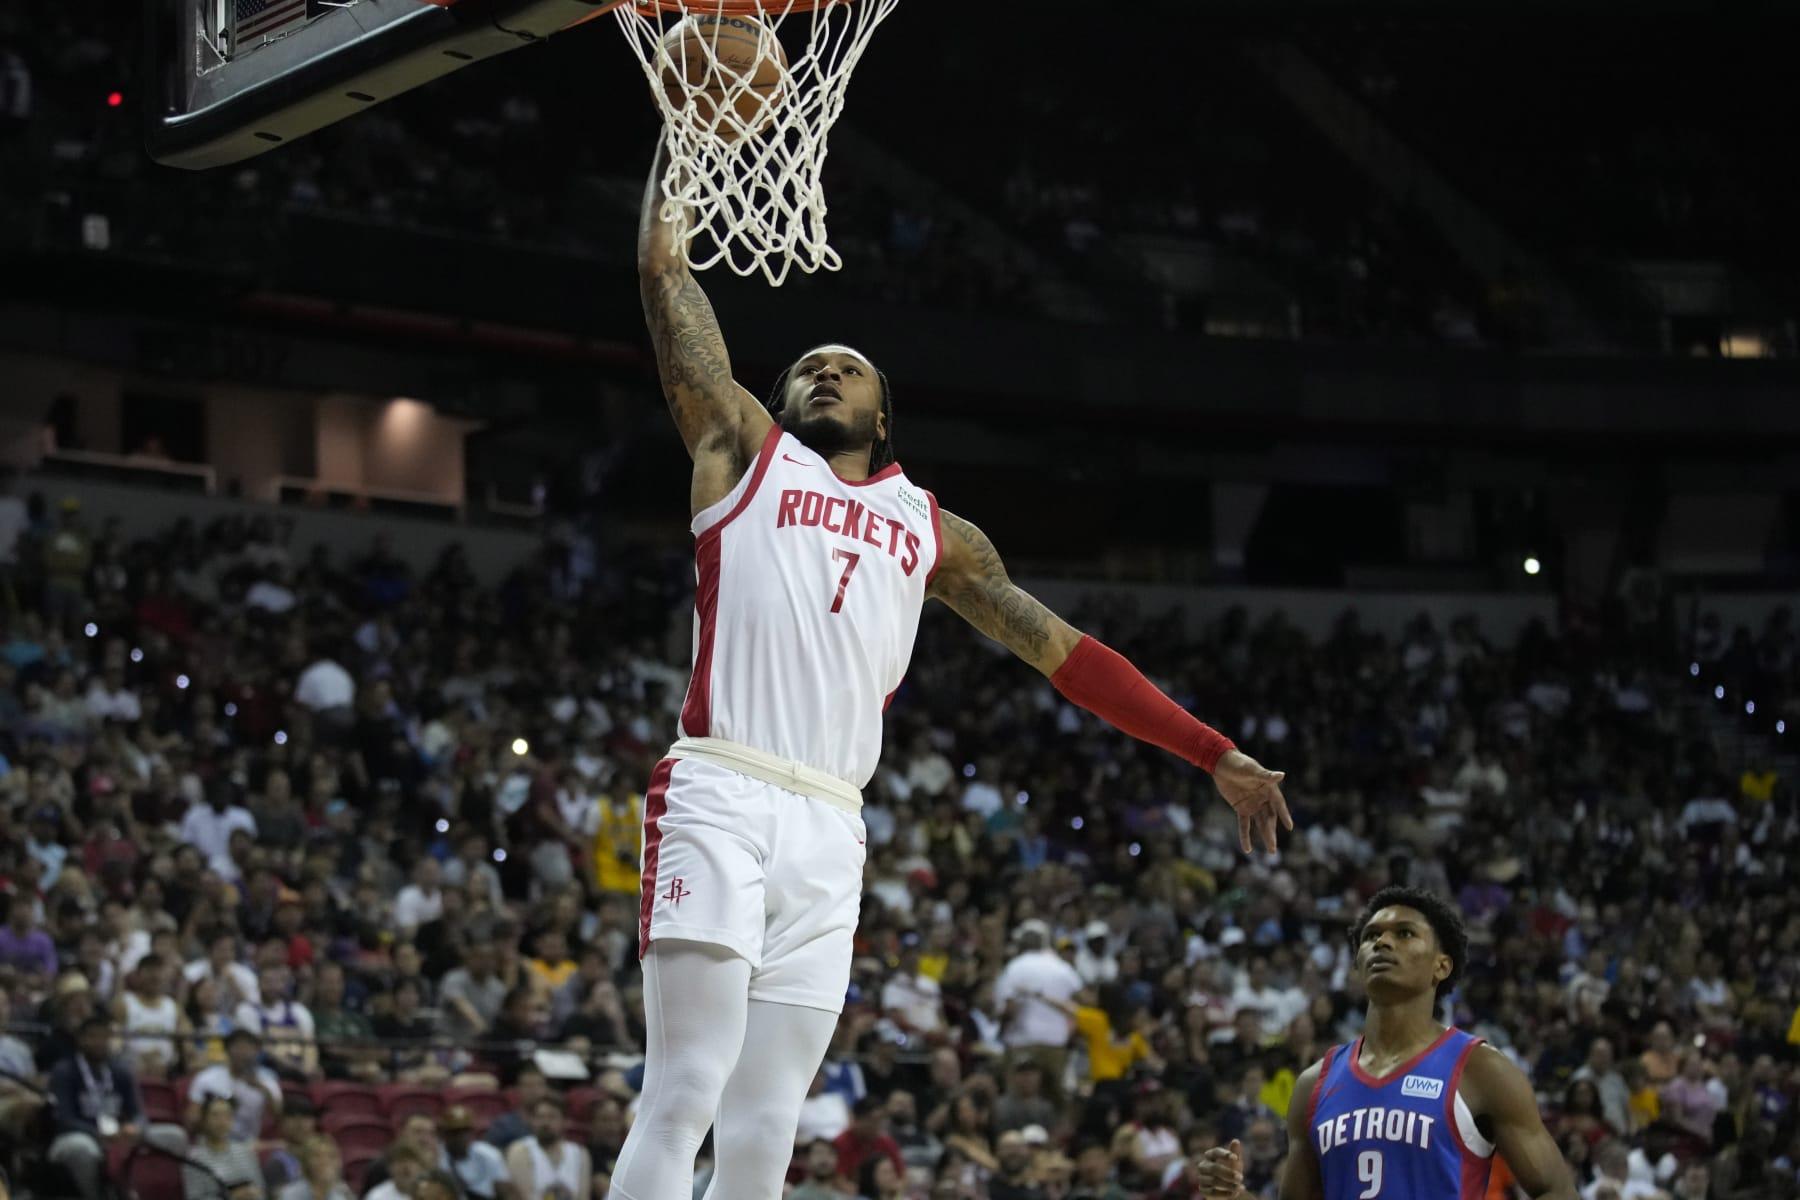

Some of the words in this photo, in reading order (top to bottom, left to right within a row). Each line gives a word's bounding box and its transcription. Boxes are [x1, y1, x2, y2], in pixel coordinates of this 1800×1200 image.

[777, 489, 920, 577] ROCKETS
[830, 547, 860, 613] 7
[1405, 1077, 1439, 1092] UWM
[1317, 1107, 1434, 1155] DETROIT
[1357, 1150, 1383, 1200] 9
